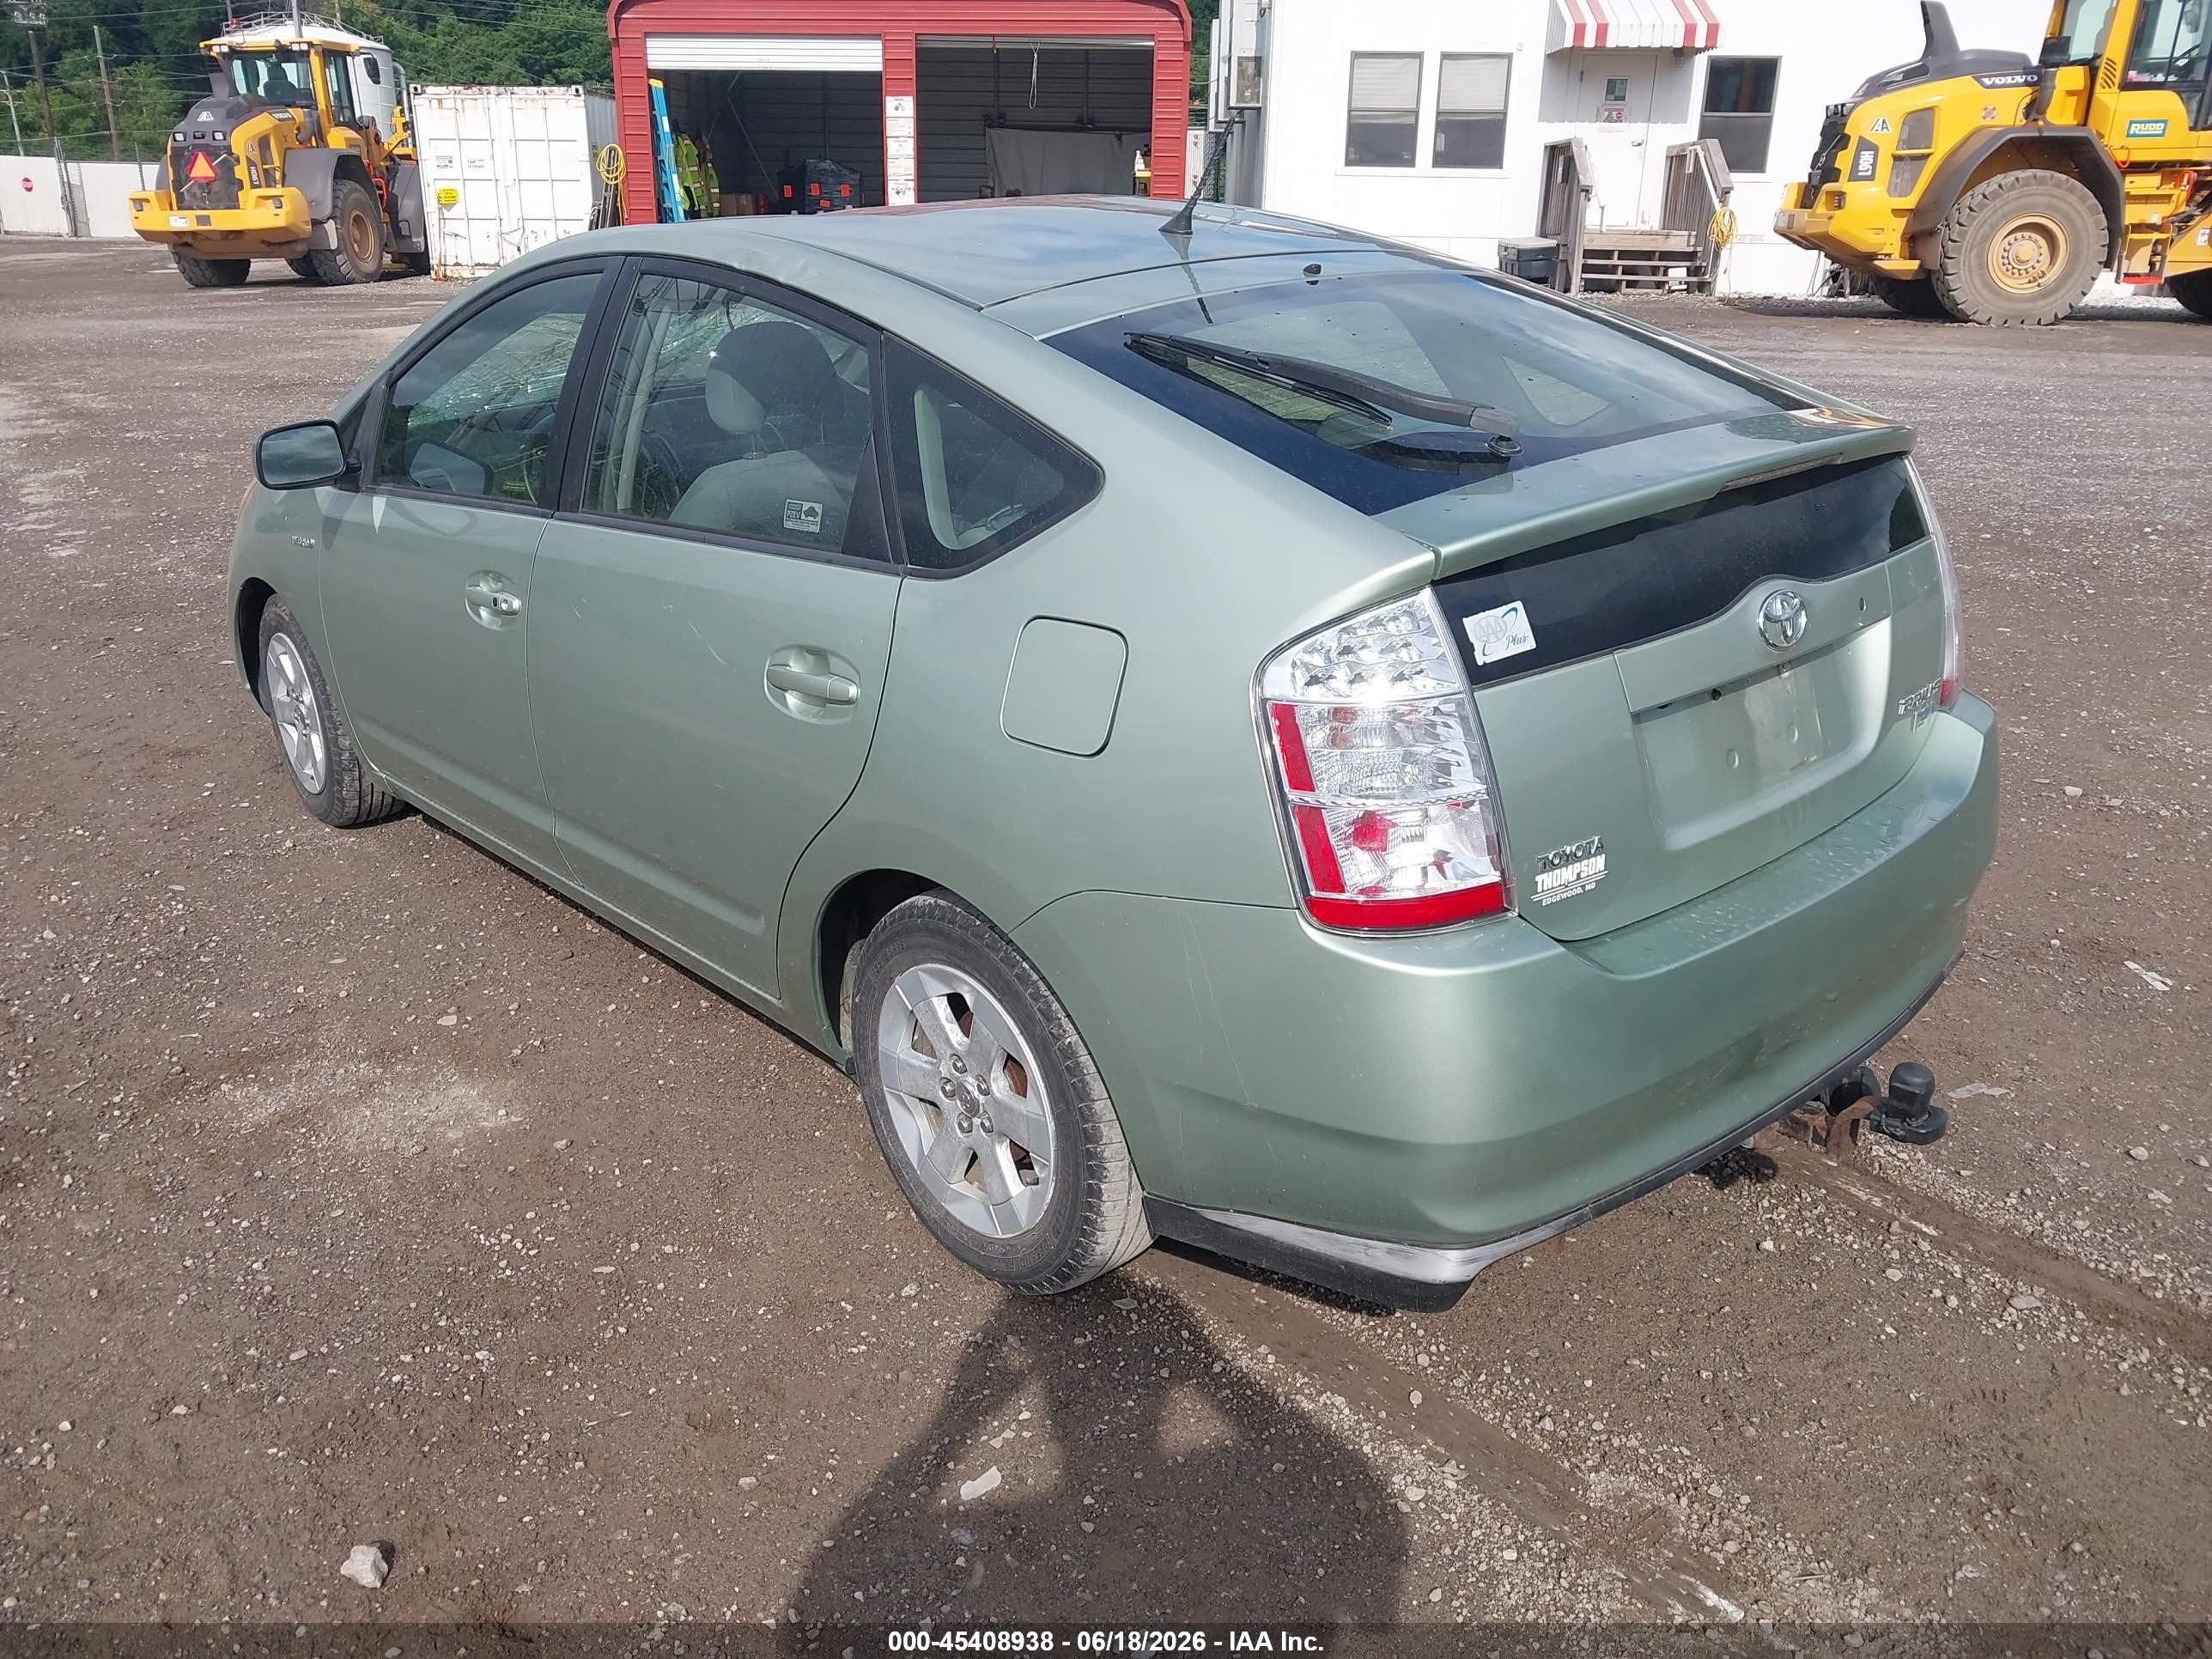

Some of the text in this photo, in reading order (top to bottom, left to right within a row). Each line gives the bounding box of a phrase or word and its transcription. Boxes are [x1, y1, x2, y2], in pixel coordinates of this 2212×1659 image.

[1980, 74, 2039, 85] VOLVO
[2130, 123, 2165, 135] RUDD
[1857, 150, 1875, 175] L90H
[1505, 633, 1528, 651] Plus
[1536, 836, 1604, 873] TOYOTA
[1535, 854, 1606, 893] THOMPSON
[1542, 882, 1596, 907] EDGEWOOD, MD
